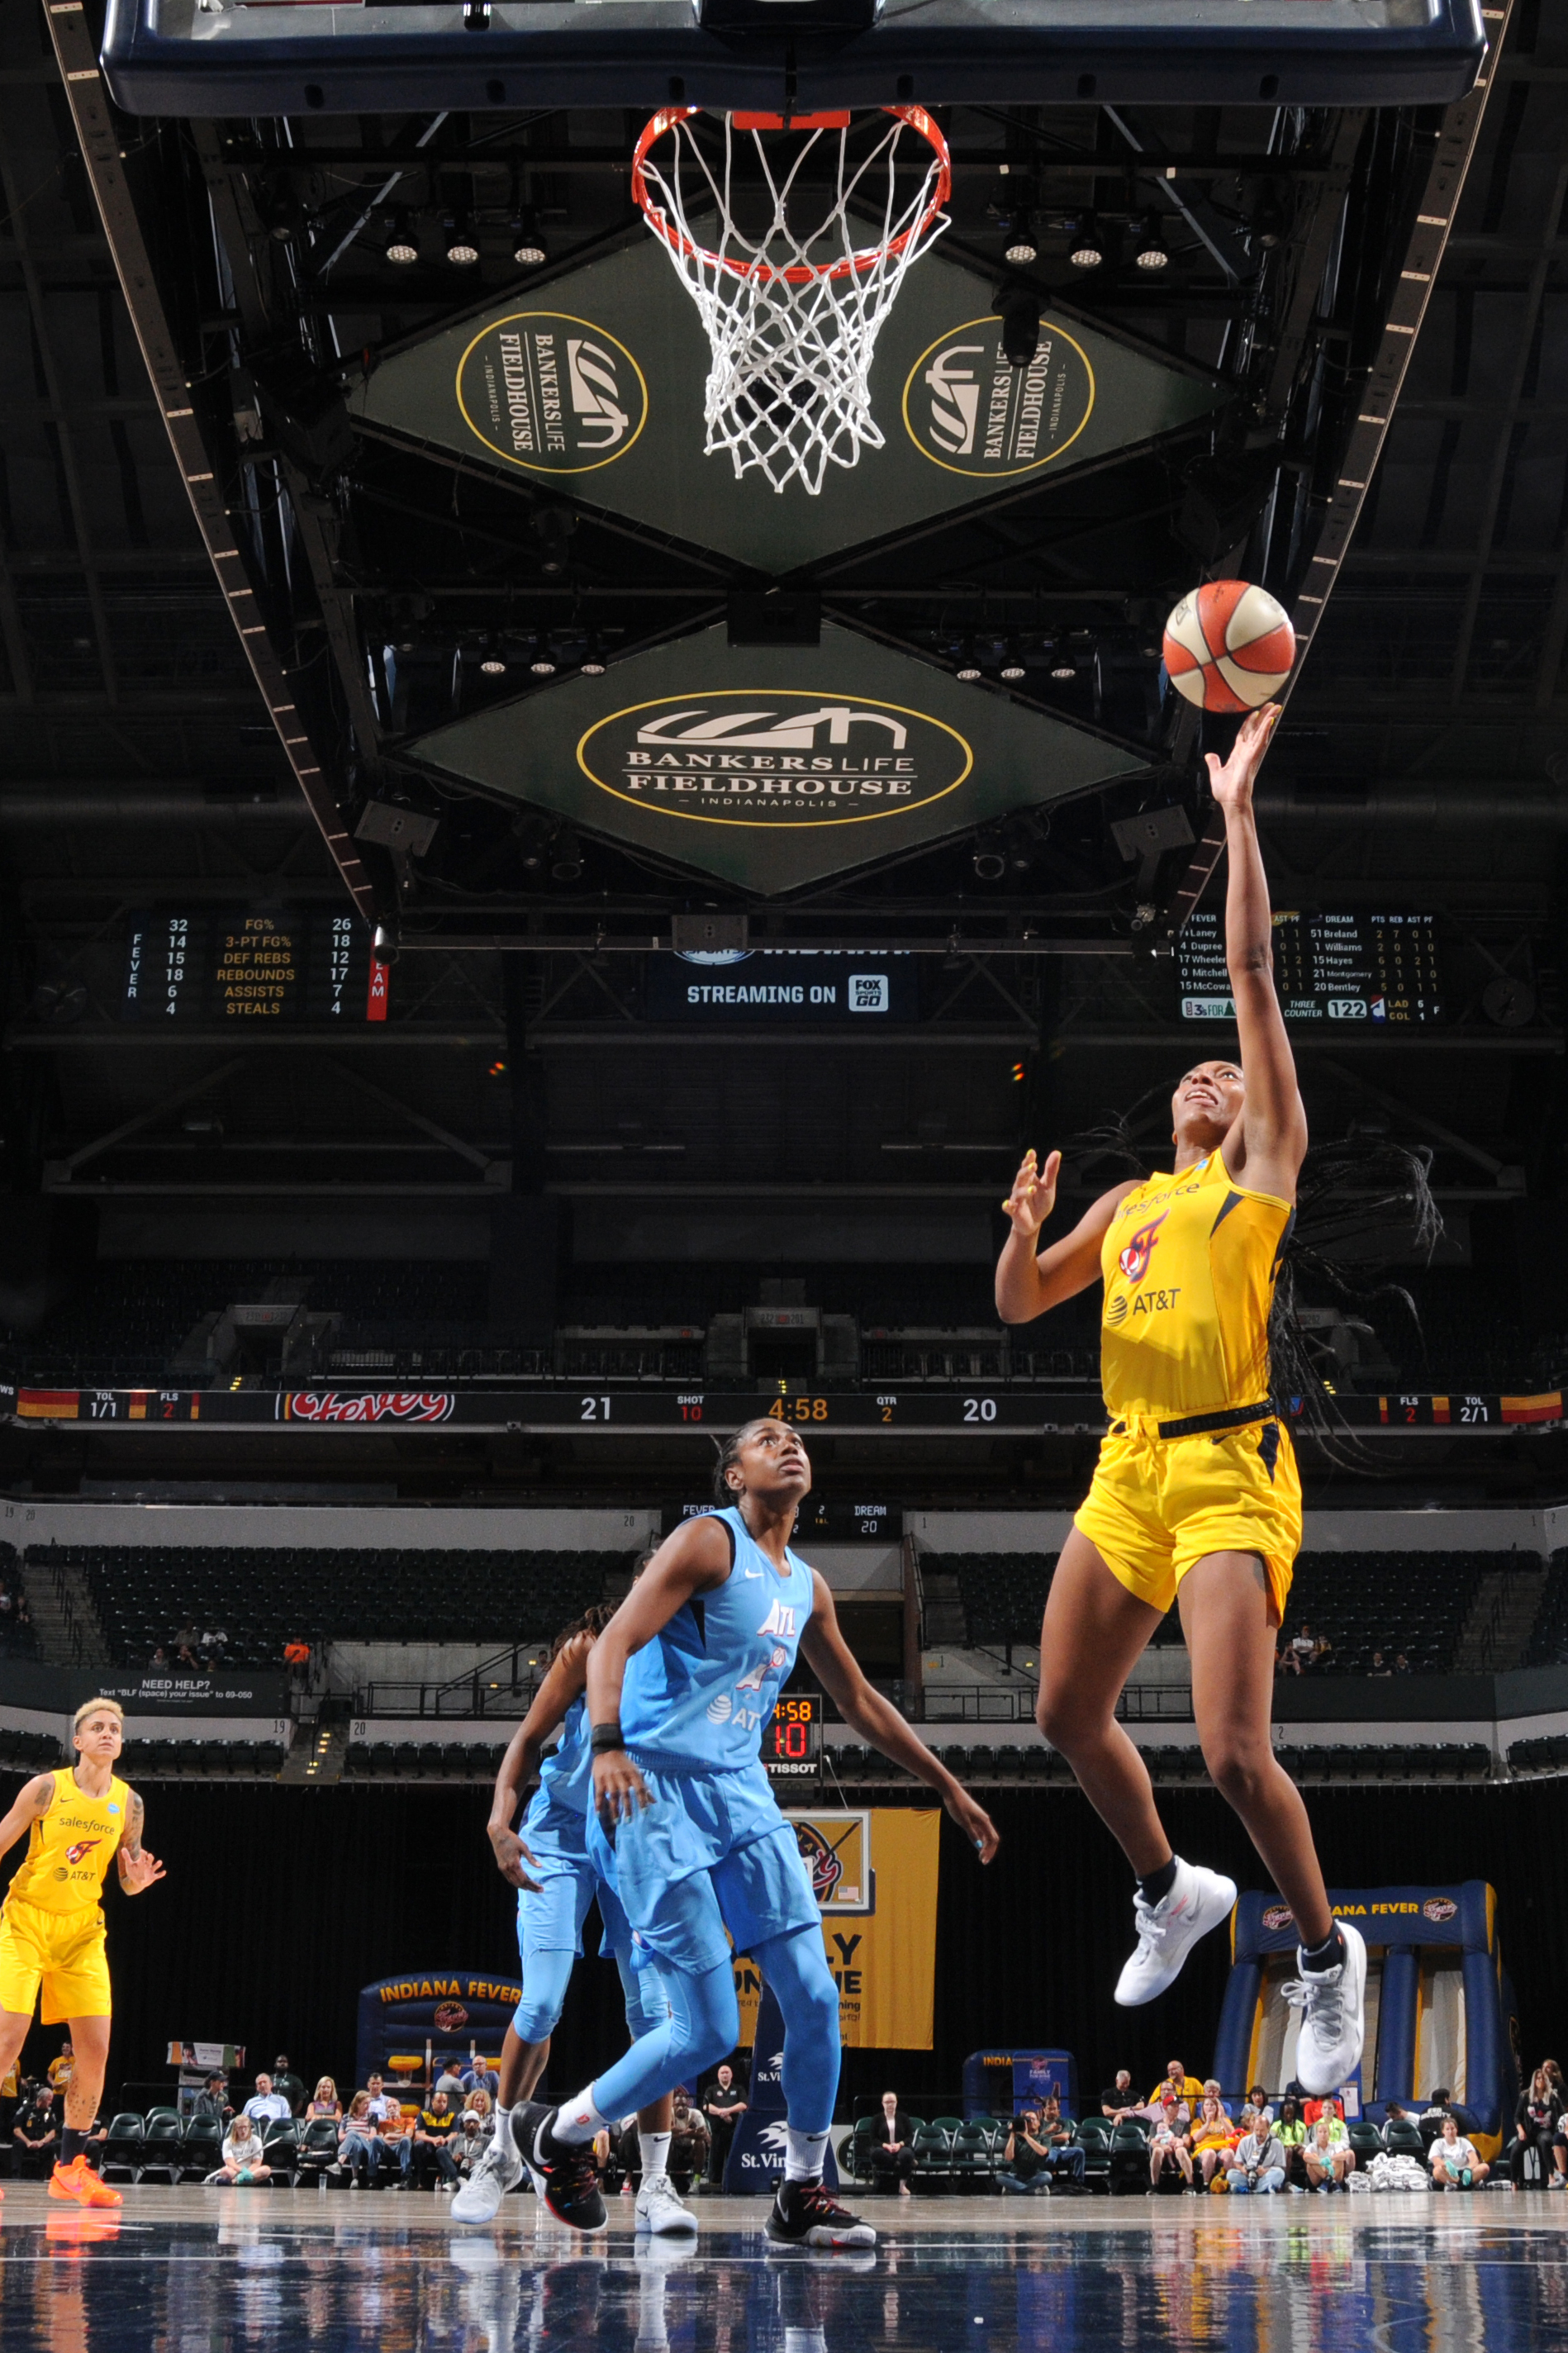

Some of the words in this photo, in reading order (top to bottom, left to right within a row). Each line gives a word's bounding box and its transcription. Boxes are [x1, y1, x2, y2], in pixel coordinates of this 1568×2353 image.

[535, 334, 562, 420] BANKERS
[484, 364, 501, 422] INDIANAPOLIS
[499, 333, 534, 451] FIELDHOUSE
[1015, 341, 1052, 459] FIELDHOUSE
[1049, 373, 1066, 431] INDIANAPOLIS
[984, 376, 1012, 459] BANKERS
[545, 422, 565, 451] LIFE
[626, 751, 833, 771] BANKERS
[842, 758, 914, 772] LIFE
[626, 775, 912, 796] FIELDHOUSE
[701, 797, 837, 807] INDIANAPOLIS
[169, 920, 188, 931] 32
[245, 920, 274, 930] FG%
[333, 918, 351, 930] 26
[1190, 929, 1217, 939] Laney
[1310, 929, 1322, 938] 51
[1323, 929, 1357, 939] Breland
[169, 936, 186, 948] 14
[226, 936, 257, 948] 3-PT
[262, 936, 292, 948] FG%
[333, 934, 350, 947] 18
[1191, 942, 1223, 951] Dupree
[168, 953, 185, 964] 15
[224, 953, 250, 964] DEF
[254, 953, 291, 964] REBS
[331, 951, 349, 963] 12
[1179, 955, 1190, 963] 17
[1191, 955, 1226, 963] Wheeler
[1313, 956, 1324, 964] 15
[1326, 957, 1353, 966] Hayes
[127, 934, 142, 998] FEVER
[1192, 968, 1228, 977] Mitchell
[166, 969, 183, 981] 18
[216, 970, 295, 981] REBOUNDS
[330, 968, 349, 980] 17
[1314, 969, 1325, 977] 21
[1327, 971, 1372, 979] Montgomery
[855, 979, 881, 990] FOX
[1180, 982, 1191, 990] 15
[1314, 982, 1326, 991] 20
[1328, 983, 1361, 993] Bentley
[168, 986, 177, 998] 6
[225, 986, 284, 997] ASSISTS
[333, 985, 342, 996] 7
[687, 986, 804, 1003] STREAMING
[810, 986, 836, 1003] ON
[856, 996, 881, 1006] GO
[1388, 1000, 1409, 1008] LAD
[166, 1002, 175, 1015] 4
[226, 1003, 280, 1015] STEALS
[331, 1001, 340, 1014] 4
[1208, 1005, 1224, 1016] FOR
[1285, 1009, 1323, 1018] COUNTER
[1331, 1002, 1363, 1017] 122
[1389, 1012, 1410, 1020] COL
[1133, 1288, 1181, 1315] AT&T
[96, 1392, 114, 1401] TOL
[160, 1393, 178, 1401] FLS
[677, 1395, 705, 1405] SHOT
[876, 1395, 897, 1405] QTR
[1399, 1396, 1419, 1405] FLS
[1464, 1396, 1484, 1405] TOL
[91, 1402, 116, 1418] 1/1
[163, 1404, 174, 1419] 2
[581, 1397, 610, 1420] 21
[681, 1406, 701, 1421] 10
[768, 1398, 828, 1422] 4:58
[881, 1407, 892, 1422] 2
[963, 1399, 996, 1422] 20
[1405, 1407, 1416, 1422] 2
[1460, 1406, 1489, 1422] 2/1
[854, 1505, 886, 1516] DREAM
[624, 1515, 634, 1527] 20
[861, 1520, 877, 1533] 20
[757, 1598, 796, 1637] ATL
[142, 1680, 173, 1689] NEED
[175, 1680, 211, 1690] HELP?
[139, 1690, 166, 1698] (space)
[772, 1701, 811, 1722] 4:58
[273, 1719, 285, 1734] 19
[354, 1721, 366, 1736] 20
[775, 1723, 806, 1757] 10
[768, 1763, 818, 1774] TISSOT
[59, 1816, 115, 1835] salesforce
[69, 1871, 96, 1881] AT&T
[1371, 1903, 1418, 1914] FEVER
[380, 1980, 462, 2003] INDIANA
[468, 1981, 522, 2004] FEVER
